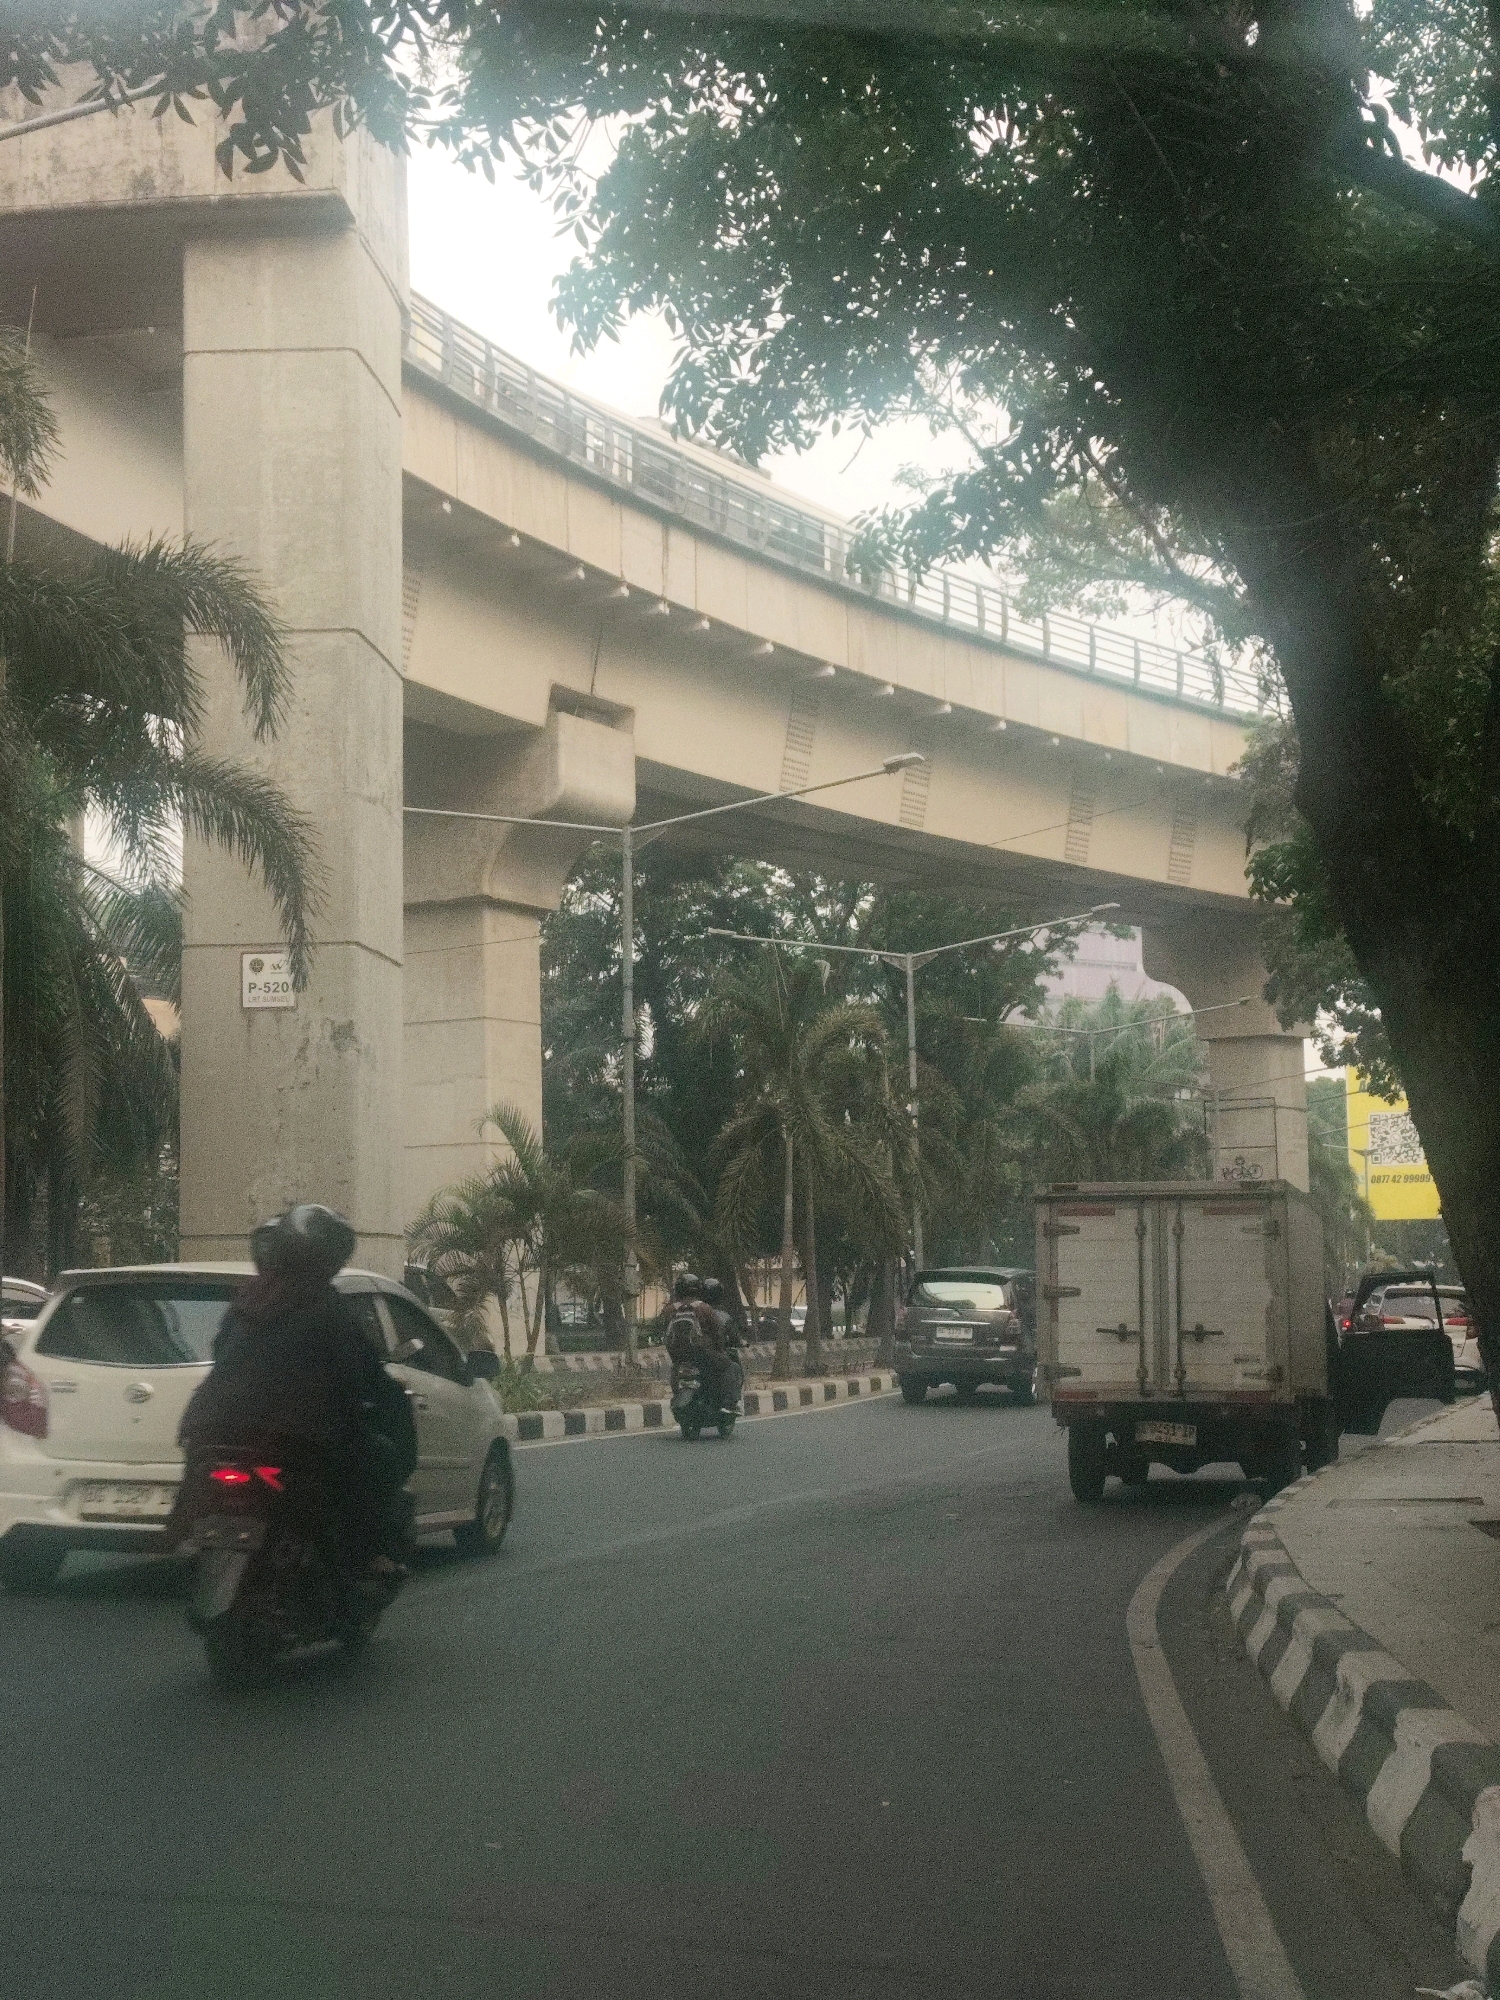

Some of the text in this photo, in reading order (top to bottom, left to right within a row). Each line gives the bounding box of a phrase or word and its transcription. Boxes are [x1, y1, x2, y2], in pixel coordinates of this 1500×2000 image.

[248, 981, 289, 993] P-520
[1371, 1175, 1390, 1184] 0877
[1391, 1174, 1402, 1183] 42
